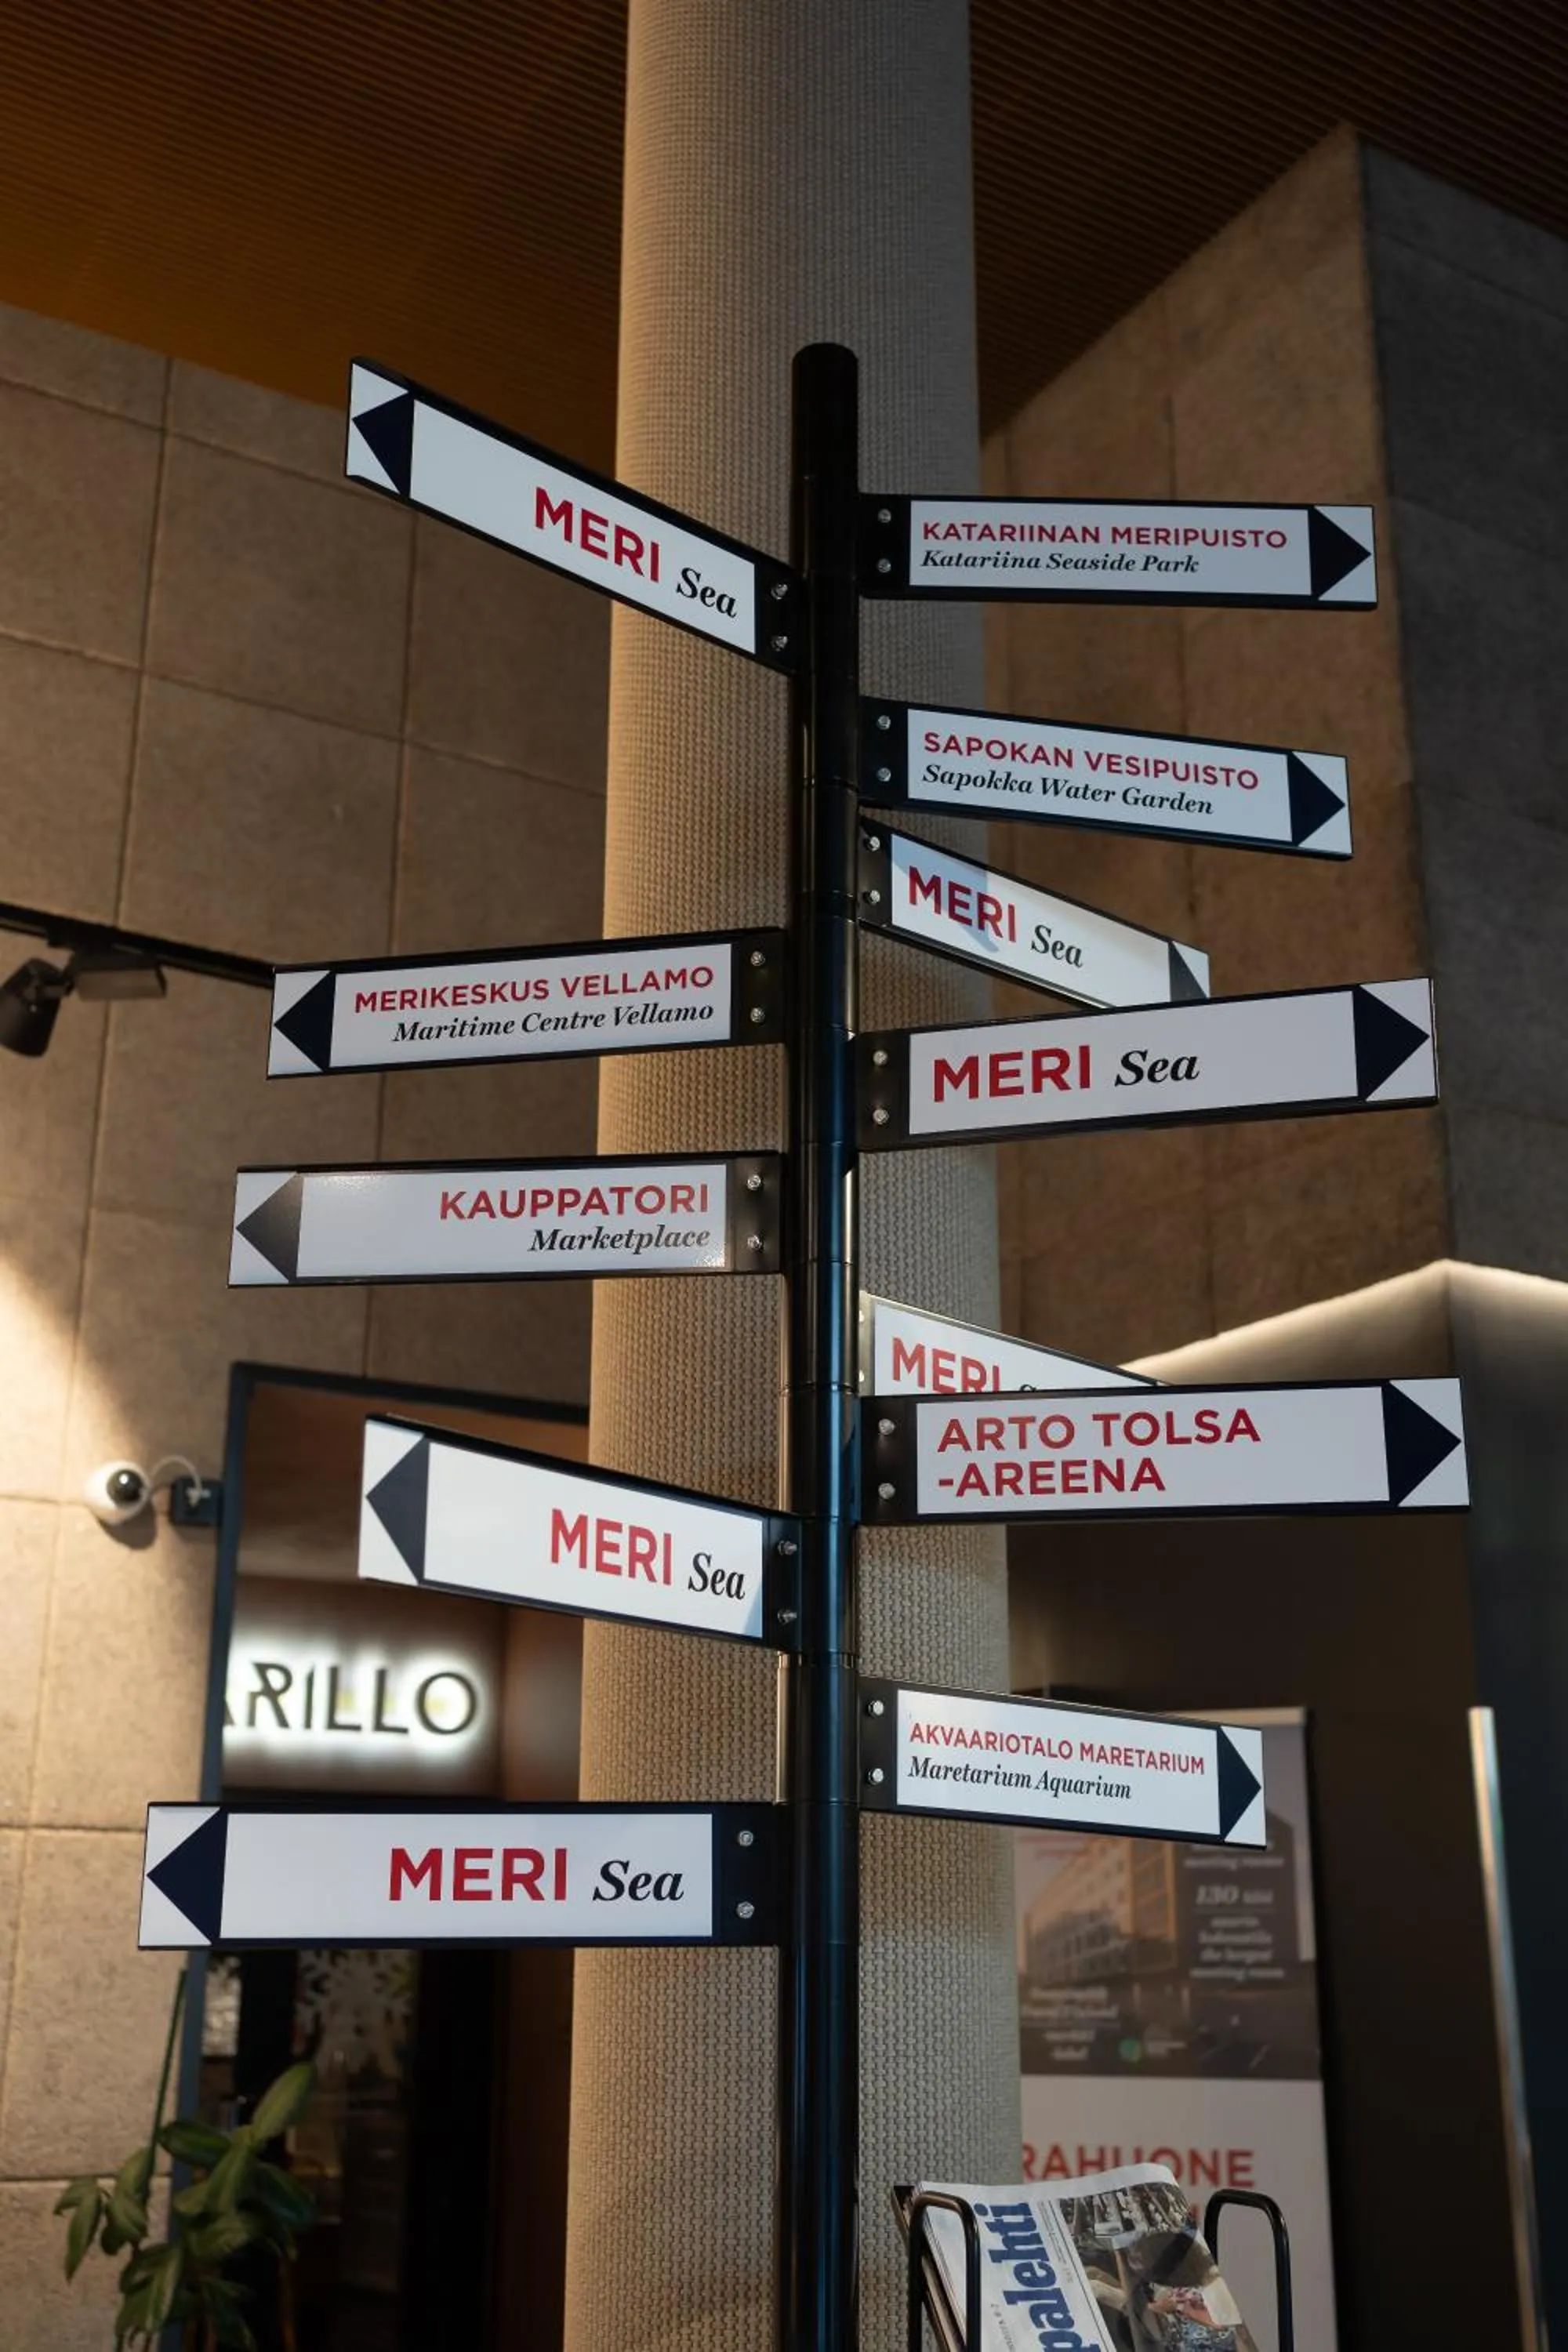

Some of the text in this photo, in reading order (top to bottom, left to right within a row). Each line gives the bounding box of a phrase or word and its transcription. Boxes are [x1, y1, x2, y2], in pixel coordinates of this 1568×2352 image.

[536, 485, 736, 618] MERI Sea
[924, 523, 1287, 548] KATARIINAN MERIPUISTO
[921, 550, 1199, 572] Katariina Seaside Park
[925, 732, 1258, 789] SAPOKAN VESIPUISTO
[923, 765, 1211, 814] Sapokka Water Garden
[909, 866, 1082, 967] MERI Sea
[355, 967, 713, 1013] MERIKESKUS VELLAMO
[393, 1003, 713, 1041] Maritime Centre Vellamo
[935, 1045, 1199, 1102] MERI Sea
[441, 1185, 707, 1219] KAUPPATORI
[528, 1225, 710, 1254] Marketplace
[938, 1409, 1261, 1452] ARTO TOLSA
[939, 1457, 1165, 1497] -AREENA
[551, 1509, 745, 1599] MERI Sea
[223, 1661, 477, 1735] RILLO
[910, 1723, 1204, 1774] AKVAARIOTALO MARETARIUM
[908, 1756, 1130, 1798] Maretarium Aquarium
[390, 1849, 684, 1900] MERI Sea
